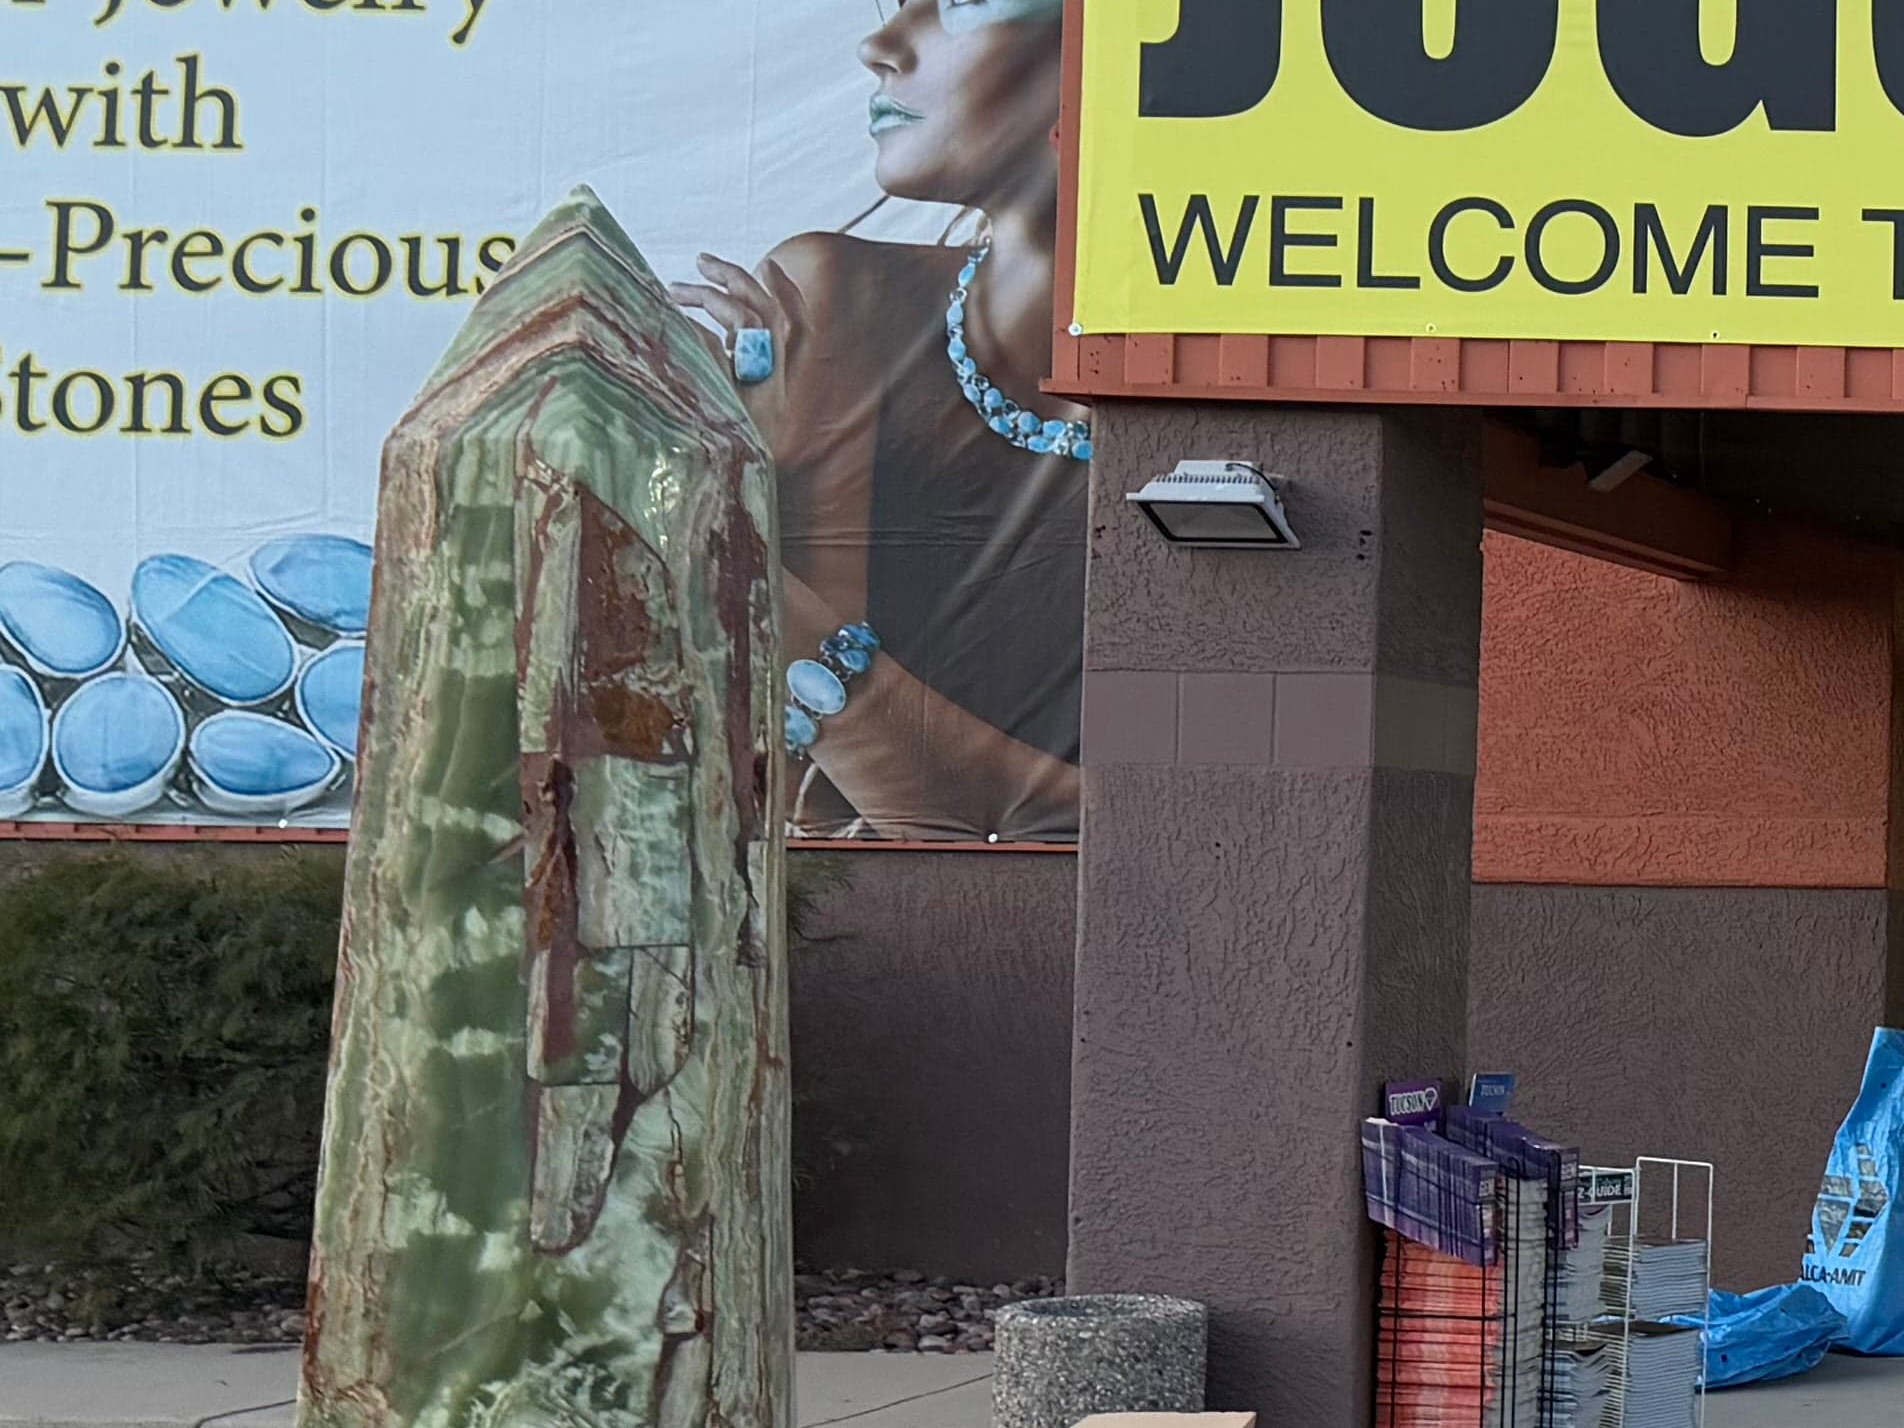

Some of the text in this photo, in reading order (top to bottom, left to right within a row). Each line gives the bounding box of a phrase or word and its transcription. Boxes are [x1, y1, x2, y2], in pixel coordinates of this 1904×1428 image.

[0, 54, 242, 149] with
[1137, 193, 1821, 298] WELCOME
[0, 353, 304, 437] tones
